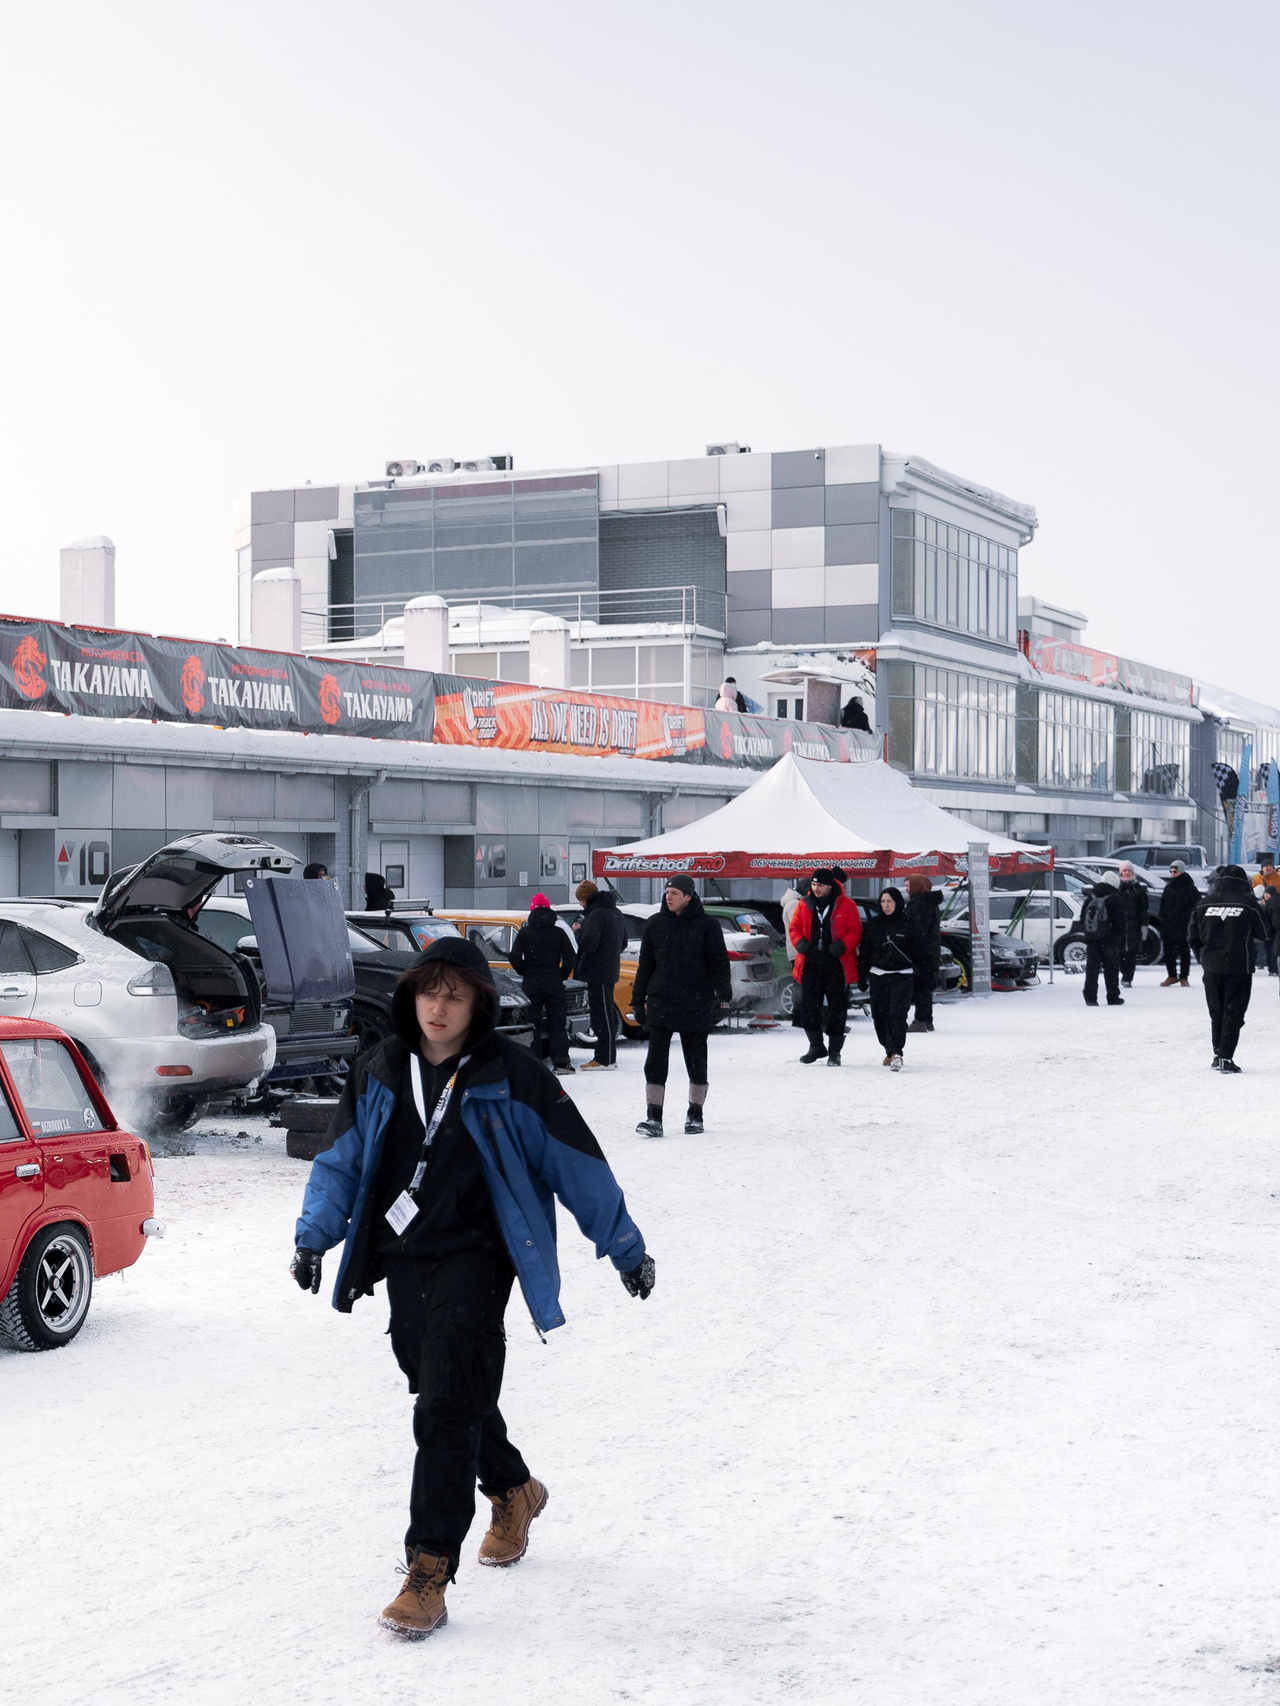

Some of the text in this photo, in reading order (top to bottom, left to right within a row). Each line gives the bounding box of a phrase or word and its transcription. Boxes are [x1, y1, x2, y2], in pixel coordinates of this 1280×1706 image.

[50, 659, 154, 699] TAKAYAMA
[208, 676, 295, 712] TAKAYAMA
[343, 691, 413, 722] TAKAYAMA
[472, 690, 494, 708] DRIFT
[531, 699, 638, 750] ALL WE NEED IS DRIFT
[79, 841, 110, 886] 10
[487, 844, 506, 878] 12
[750, 858, 878, 869] ОБУЧЕНИЕ ДРИФТУ В МОСКВЕ
